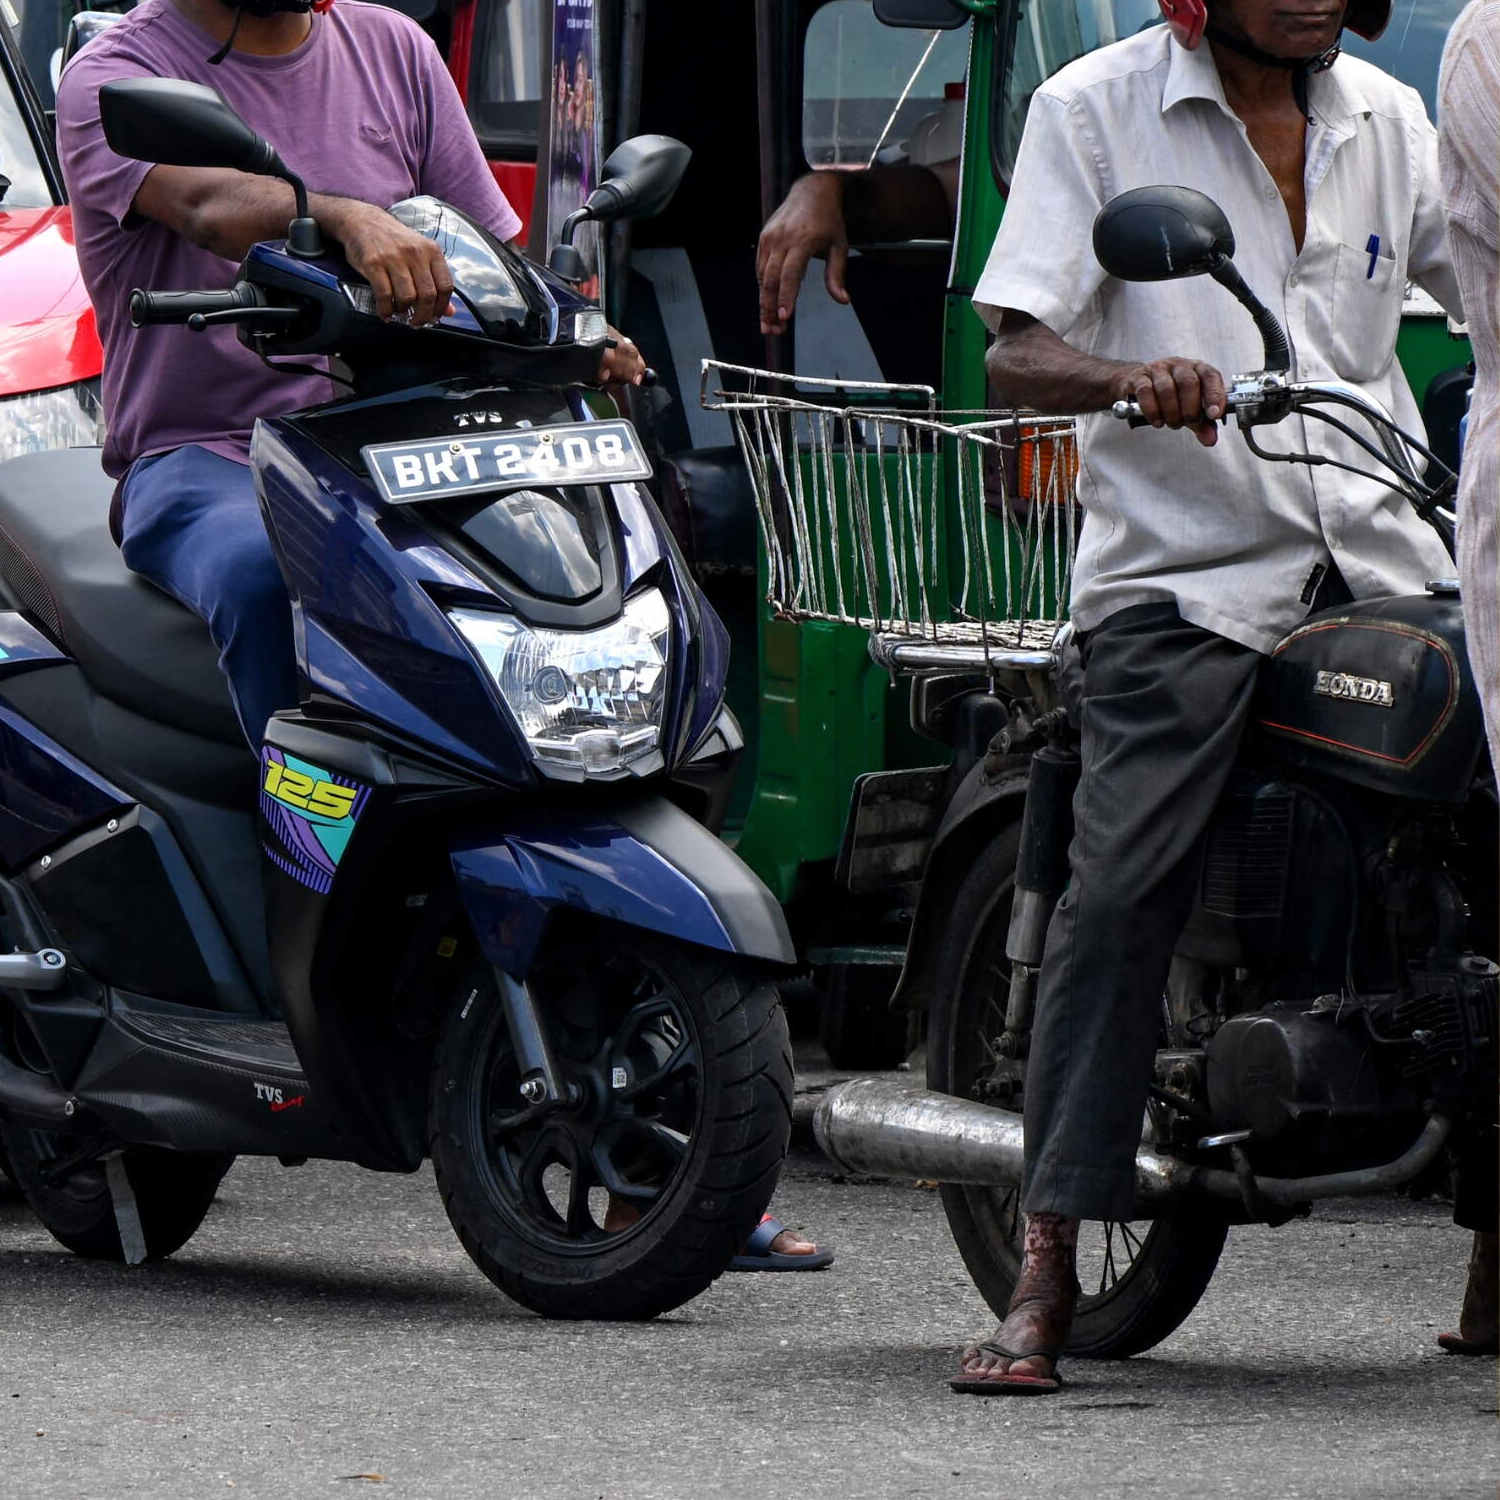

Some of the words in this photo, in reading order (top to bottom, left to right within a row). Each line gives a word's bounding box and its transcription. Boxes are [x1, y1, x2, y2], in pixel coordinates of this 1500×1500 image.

[453, 410, 503, 427] TVS
[392, 446, 482, 488] BKT
[493, 434, 626, 475] 2408
[1313, 670, 1394, 706] HONDA
[264, 758, 358, 819] 125
[253, 1082, 283, 1104] TVS
